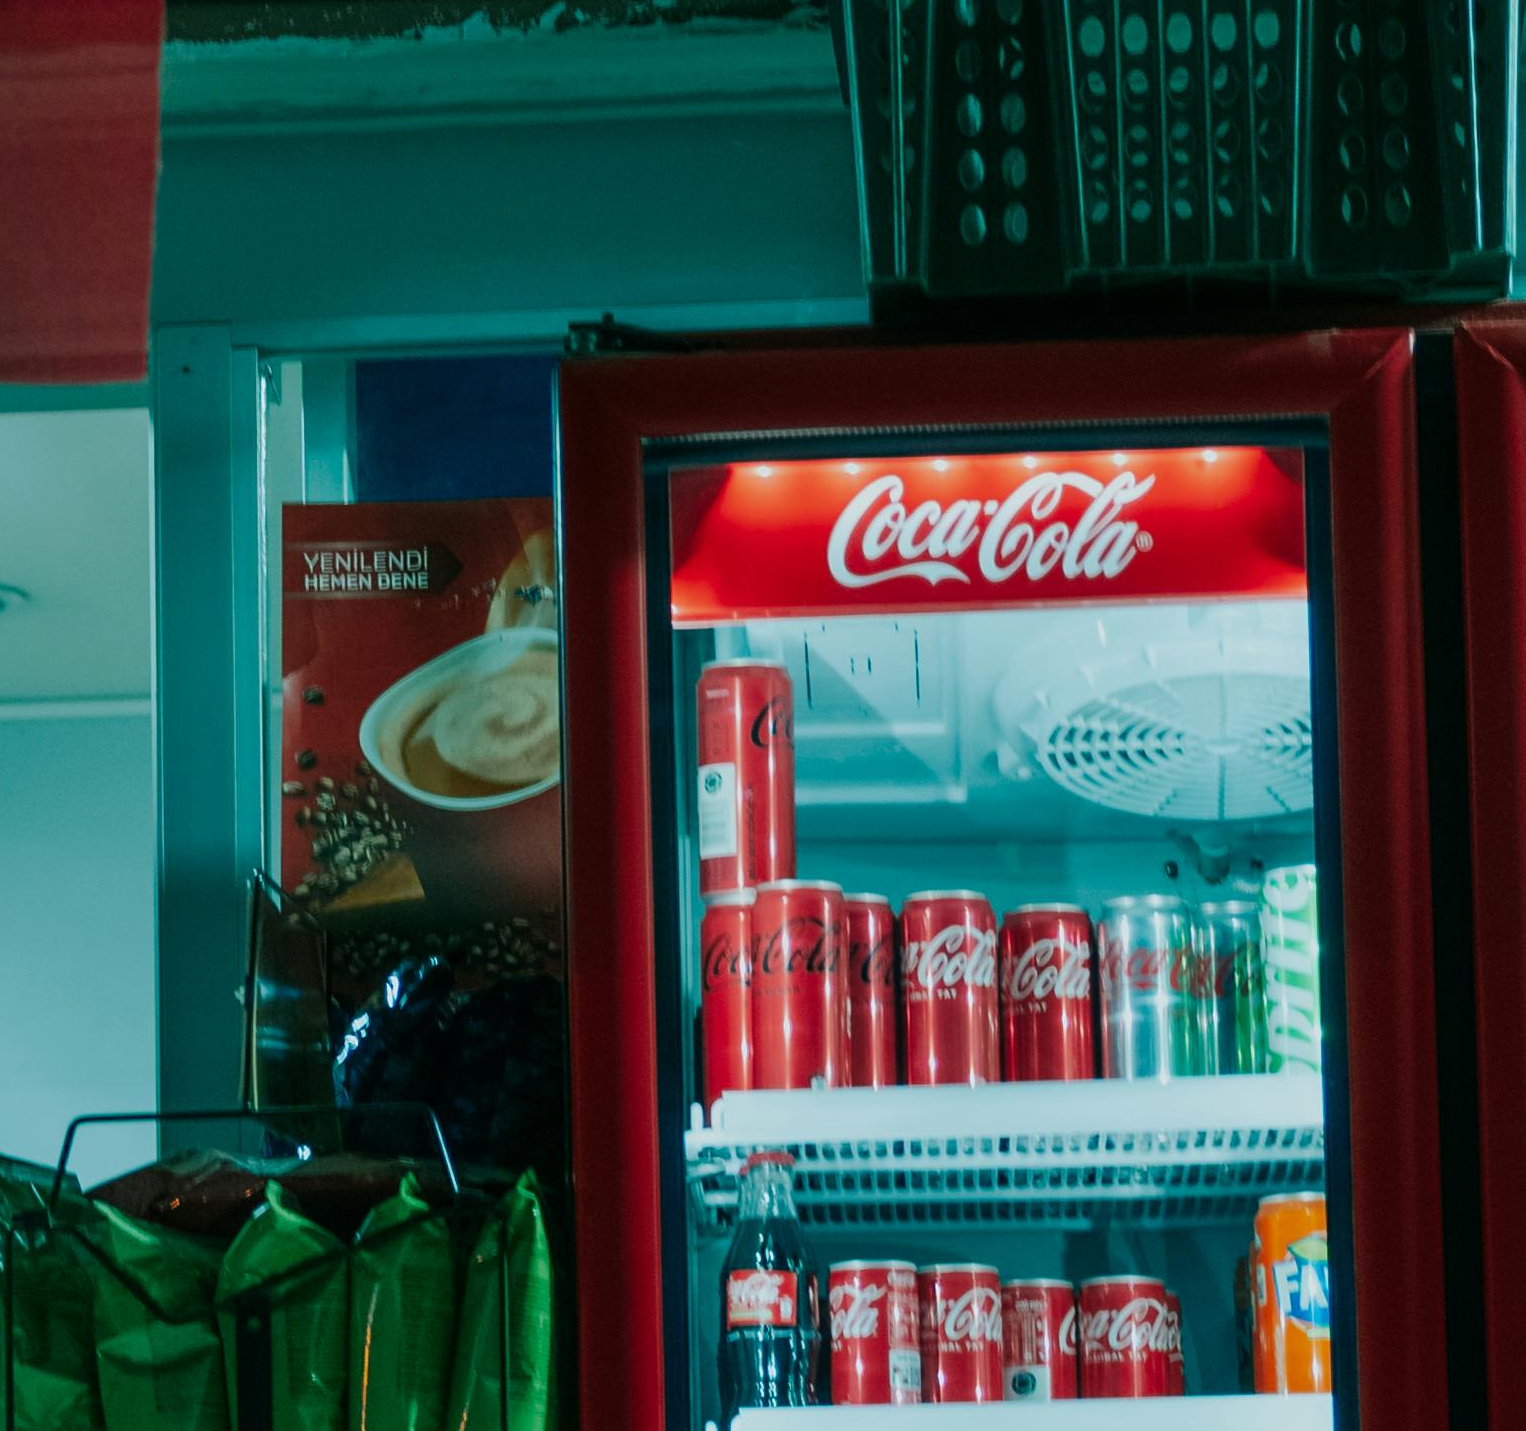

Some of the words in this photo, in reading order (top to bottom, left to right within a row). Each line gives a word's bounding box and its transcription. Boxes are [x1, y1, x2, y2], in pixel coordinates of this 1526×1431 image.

[827, 471, 1155, 588] Coca-Cola
[304, 545, 429, 573] YENİLENDİ
[305, 573, 373, 592] HEMEN
[378, 571, 429, 590] DENE
